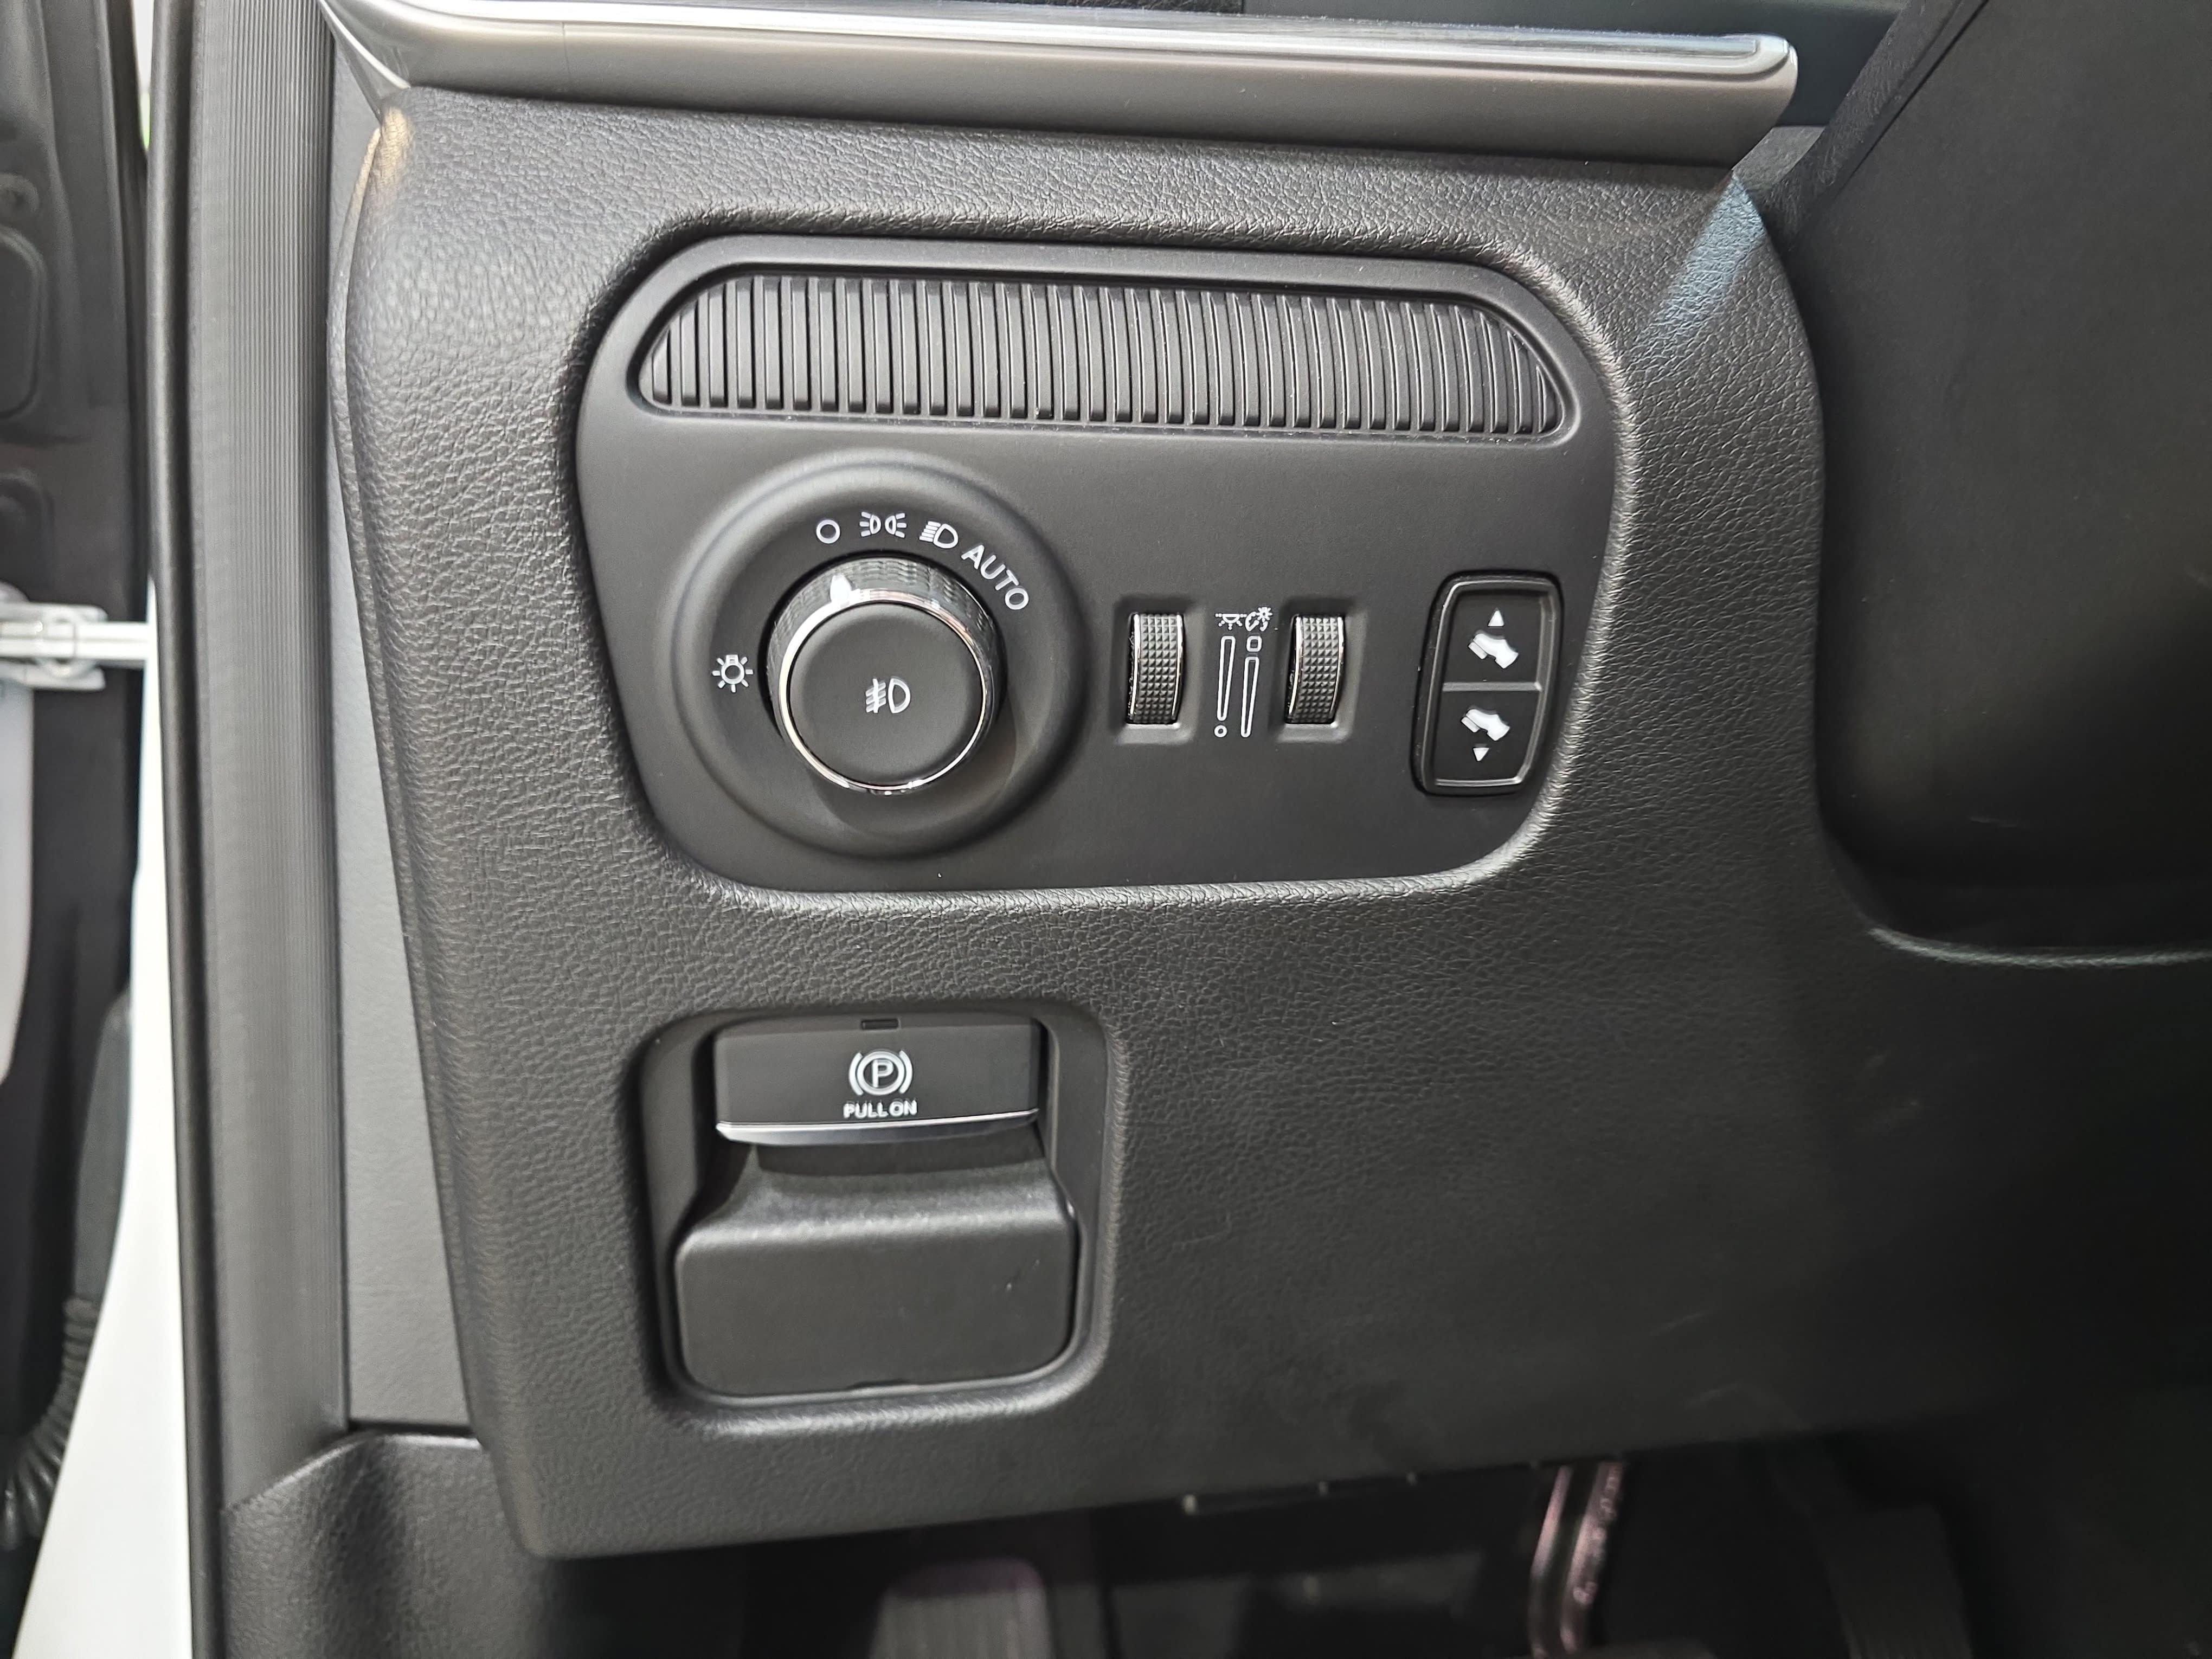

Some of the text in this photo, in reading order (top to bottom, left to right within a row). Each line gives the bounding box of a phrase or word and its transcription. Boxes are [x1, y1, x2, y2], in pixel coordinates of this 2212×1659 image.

[961, 545, 1029, 610] AUTO
[872, 1059, 893, 1087] P
[844, 1099, 917, 1118] PULL ON
